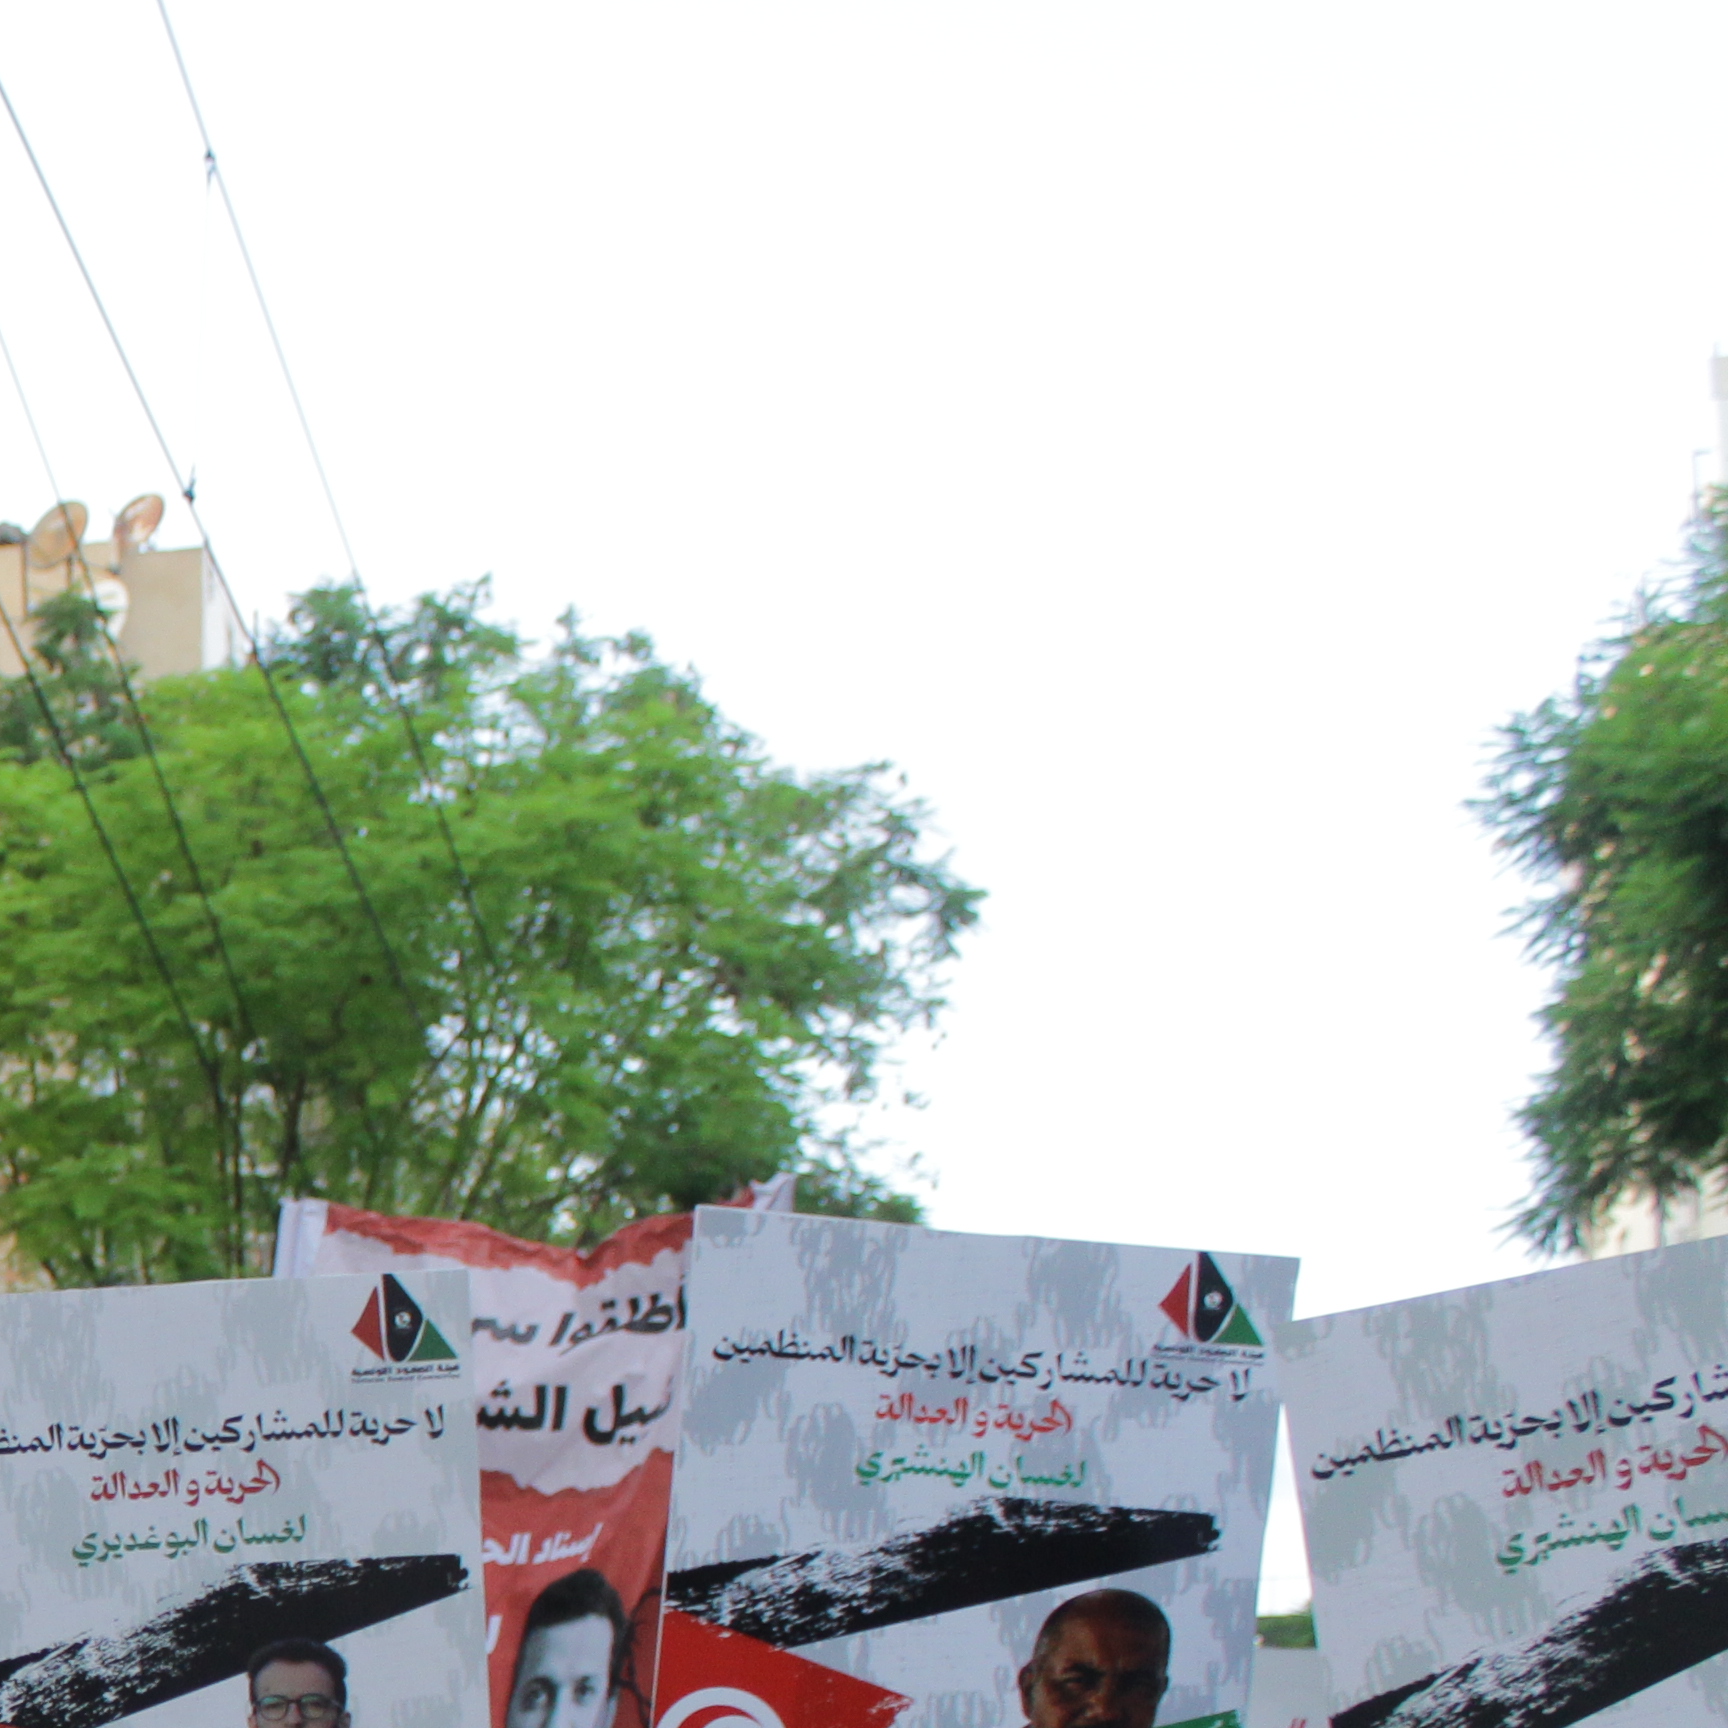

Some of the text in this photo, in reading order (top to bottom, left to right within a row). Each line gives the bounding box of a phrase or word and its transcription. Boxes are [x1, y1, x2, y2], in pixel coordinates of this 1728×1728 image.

[713, 1330, 856, 1364] المنظمين
[979, 1351, 1149, 1391] للمشاركين
[1150, 1363, 1222, 1401] حرية
[424, 1404, 444, 1440] لا
[876, 1392, 969, 1426] العدالة
[971, 1410, 988, 1438] و
[183, 1407, 345, 1452] للمشاركين
[348, 1411, 418, 1446] حرية
[1311, 1412, 1465, 1480] المنظمين
[90, 1467, 181, 1502] العدالة
[988, 1456, 1088, 1490] لغسان
[1502, 1448, 1607, 1499] العدالة
[1615, 1457, 1634, 1491] و
[184, 1479, 201, 1507] و
[212, 1514, 308, 1554] لغسان
